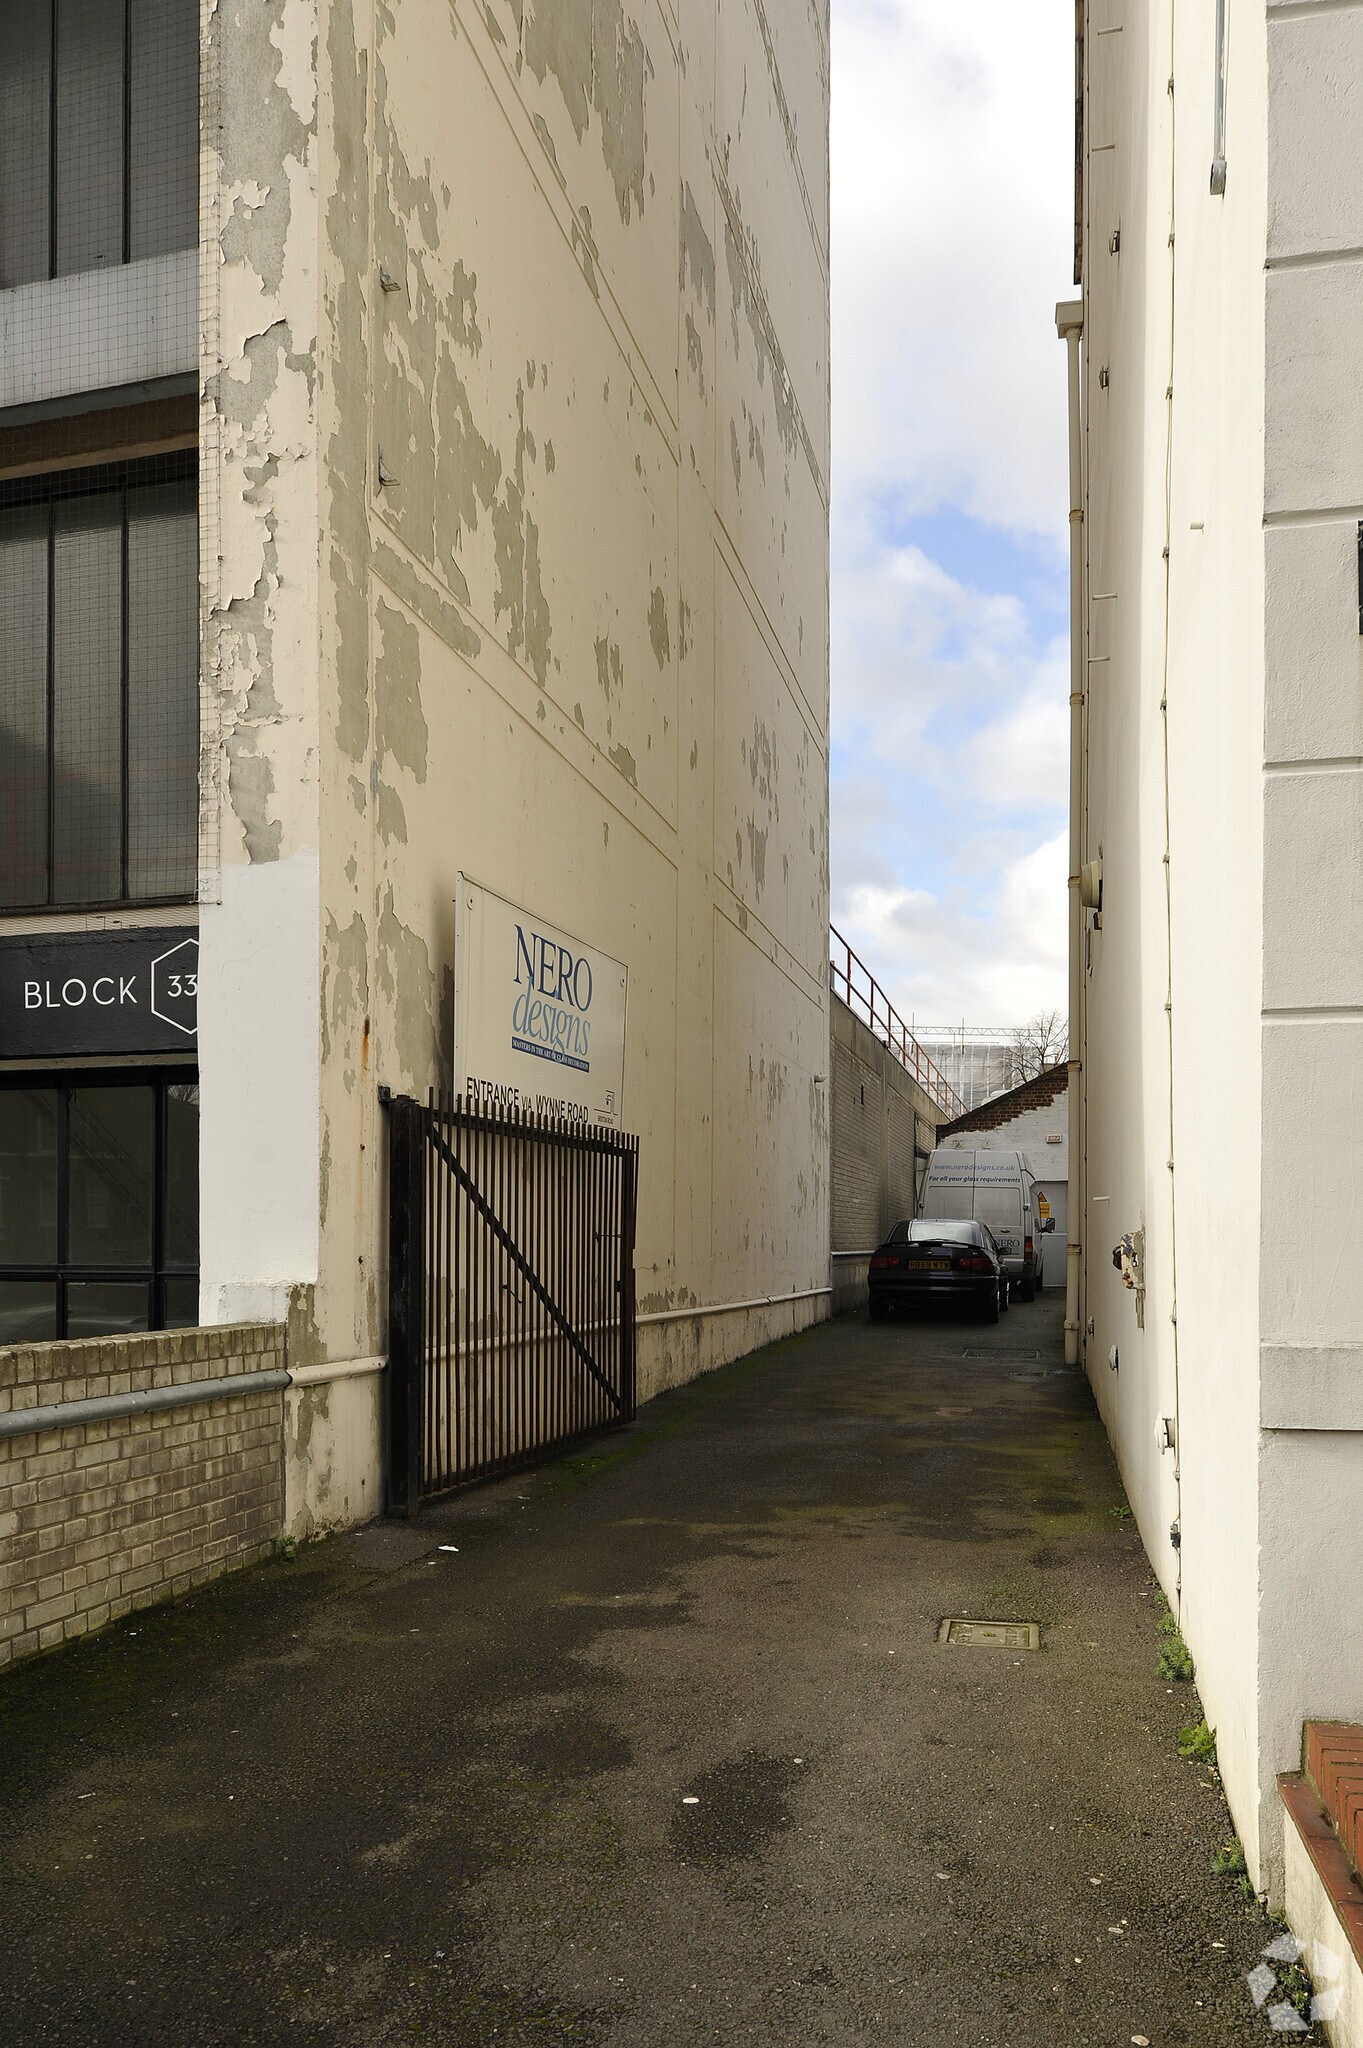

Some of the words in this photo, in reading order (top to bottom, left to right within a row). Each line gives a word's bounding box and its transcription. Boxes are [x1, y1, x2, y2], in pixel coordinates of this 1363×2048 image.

[167, 974, 197, 998] 33
[513, 924, 592, 1012] NERO
[24, 976, 138, 1009] BLOCK
[513, 976, 591, 1063] designs
[466, 1077, 520, 1108] ENTRANCE
[521, 1095, 532, 1111] VIA
[535, 1094, 566, 1119] WYNNE
[567, 1102, 589, 1124] ROAD
[934, 1163, 1016, 1172] www.nerodesigns.co.uk
